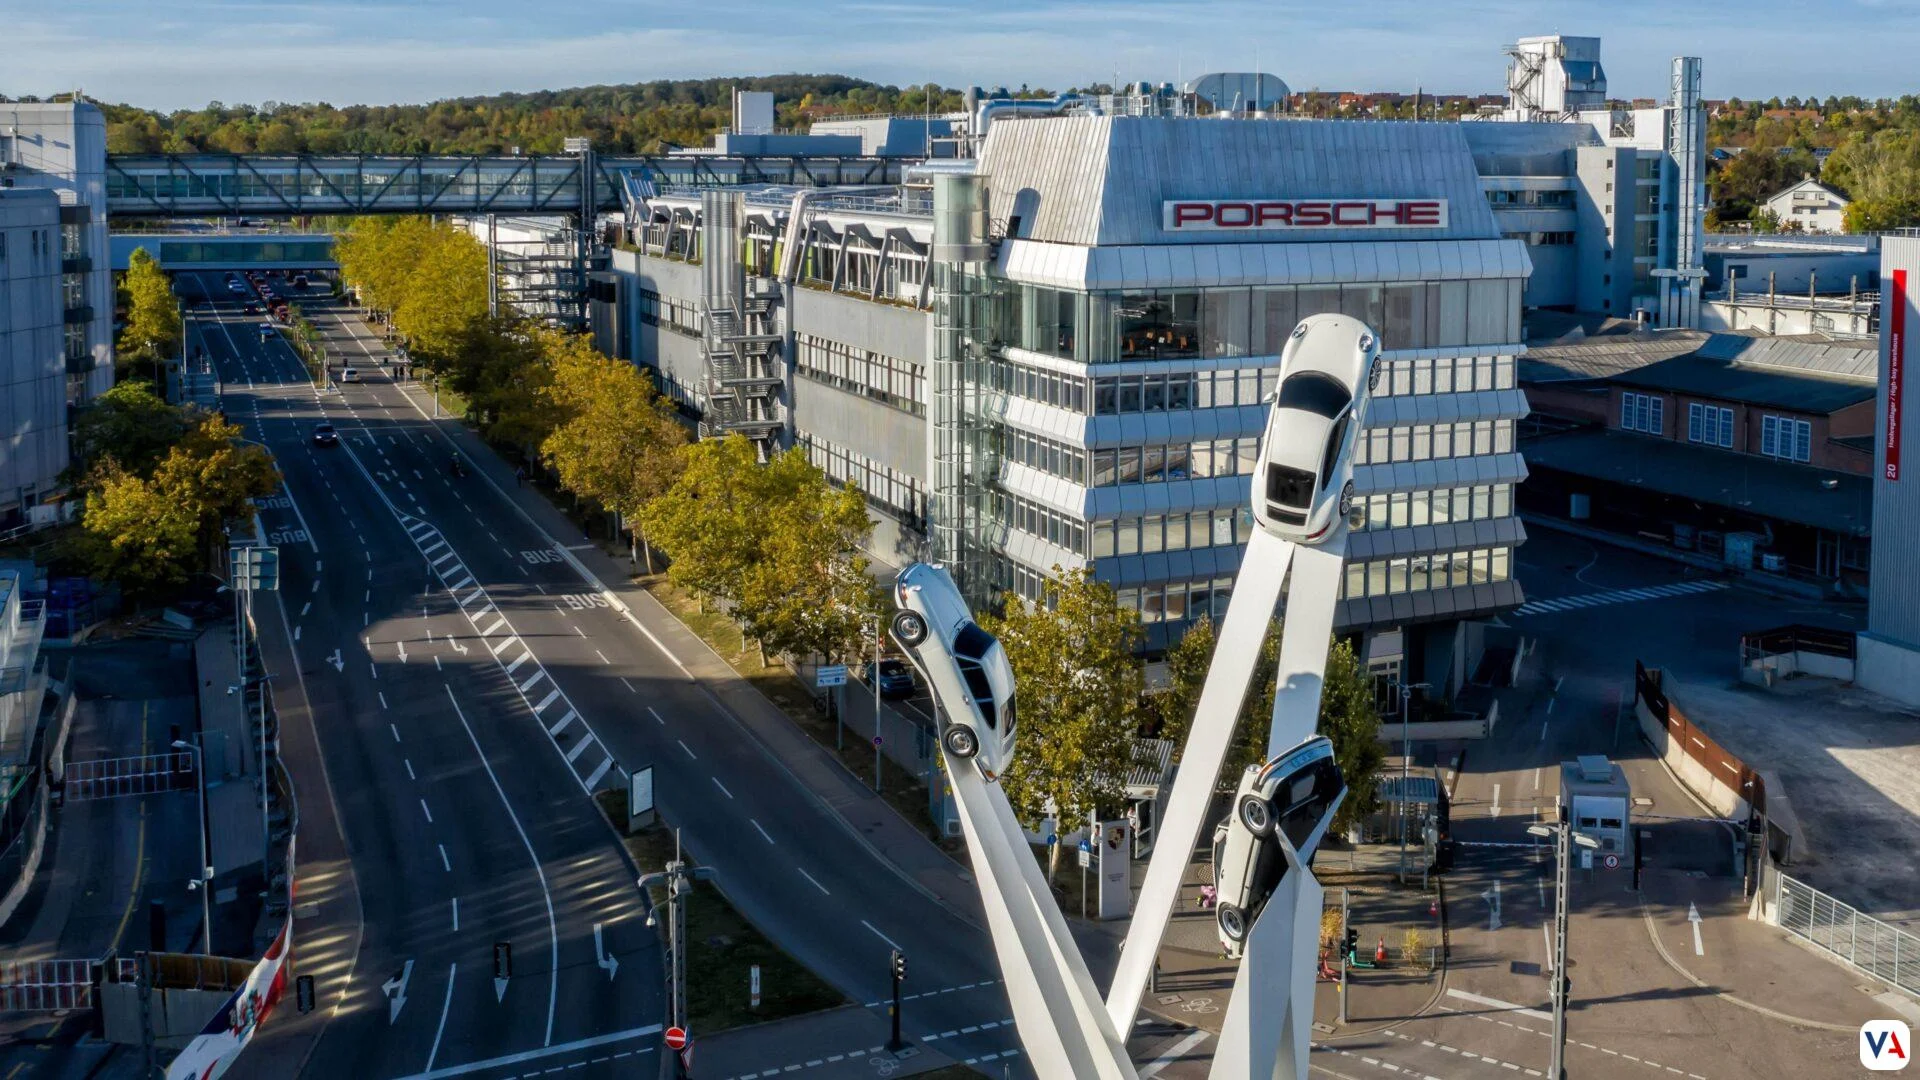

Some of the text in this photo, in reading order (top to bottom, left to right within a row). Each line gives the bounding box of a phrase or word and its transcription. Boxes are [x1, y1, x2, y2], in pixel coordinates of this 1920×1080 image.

[1174, 202, 1440, 228] PORSCHE
[1890, 367, 1898, 397] High-bay
[1887, 463, 1896, 479] 20
[269, 530, 308, 544] BUS
[520, 550, 562, 564] BUS
[560, 593, 609, 610] BUS
